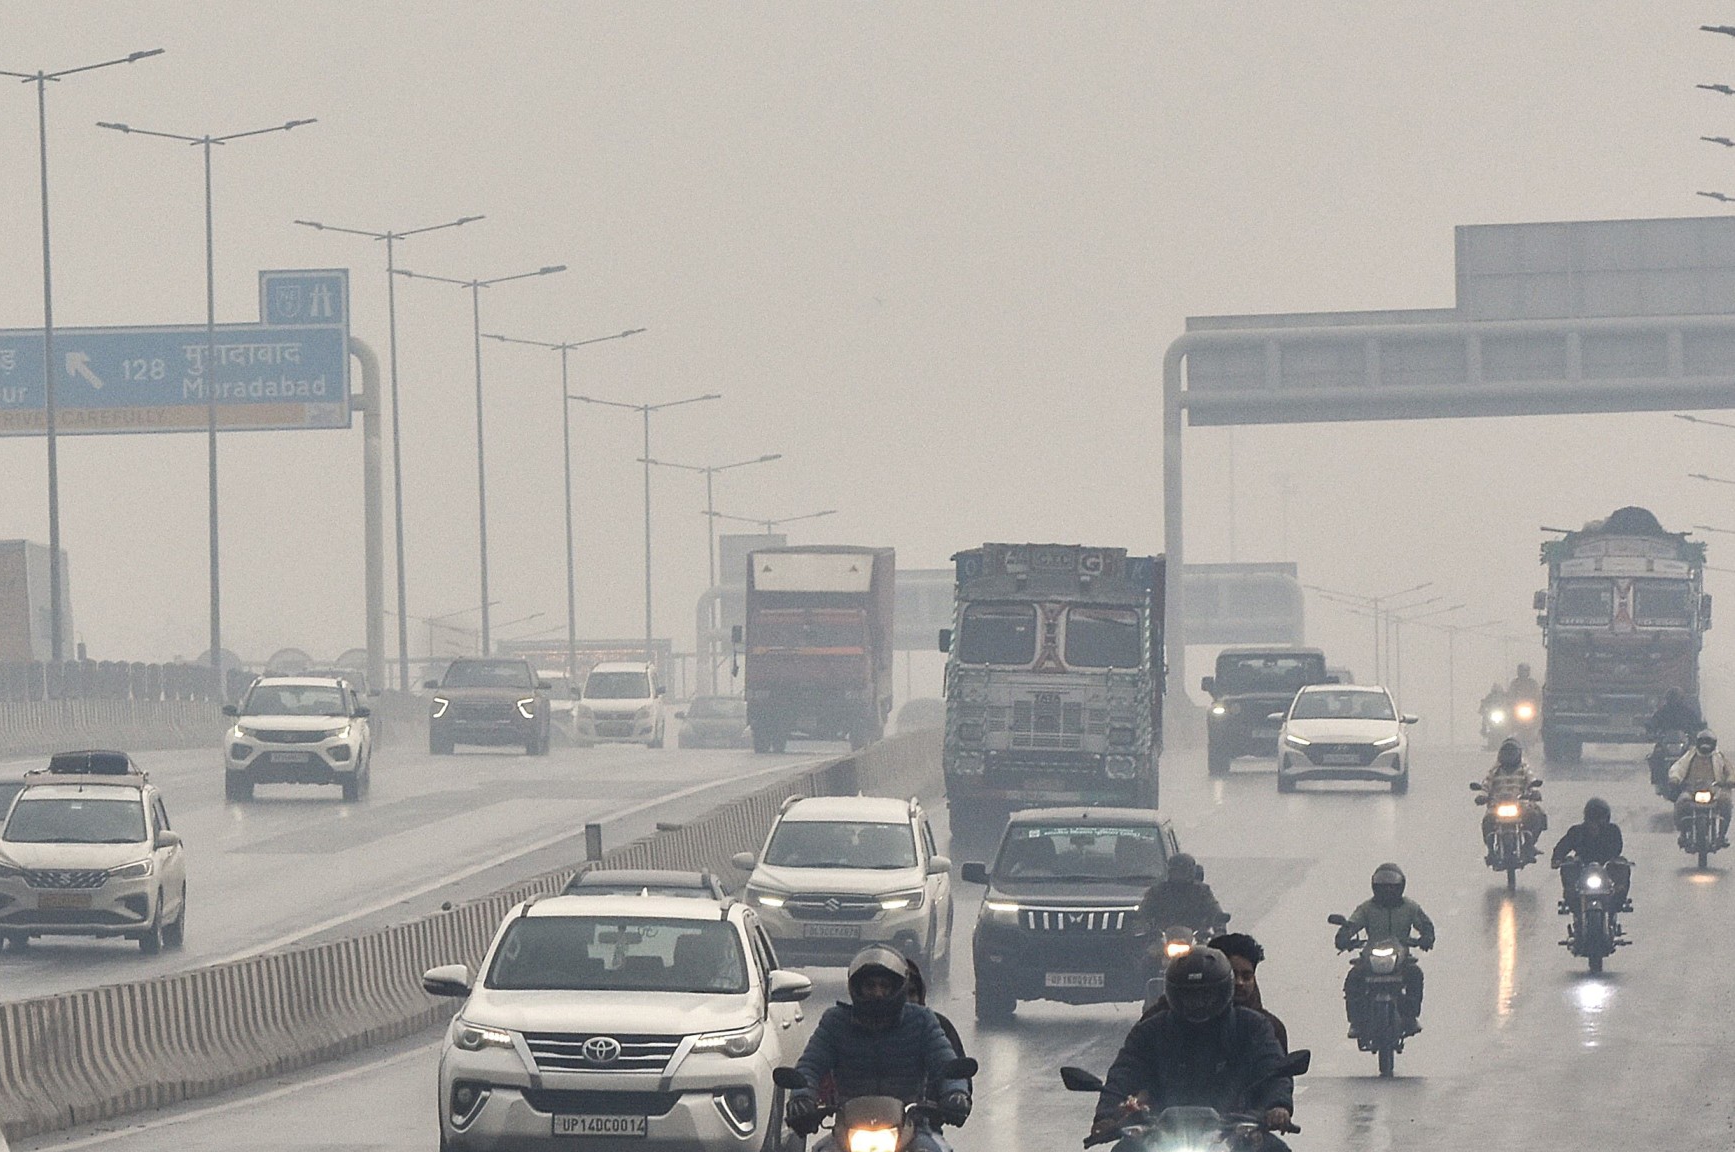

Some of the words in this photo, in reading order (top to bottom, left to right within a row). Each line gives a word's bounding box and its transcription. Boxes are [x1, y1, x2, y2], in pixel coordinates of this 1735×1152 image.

[121, 358, 166, 381] 128
[61, 407, 166, 426] CAREFULLY
[1034, 693, 1062, 704] TATA
[562, 1118, 645, 1133] UP14DC0014
